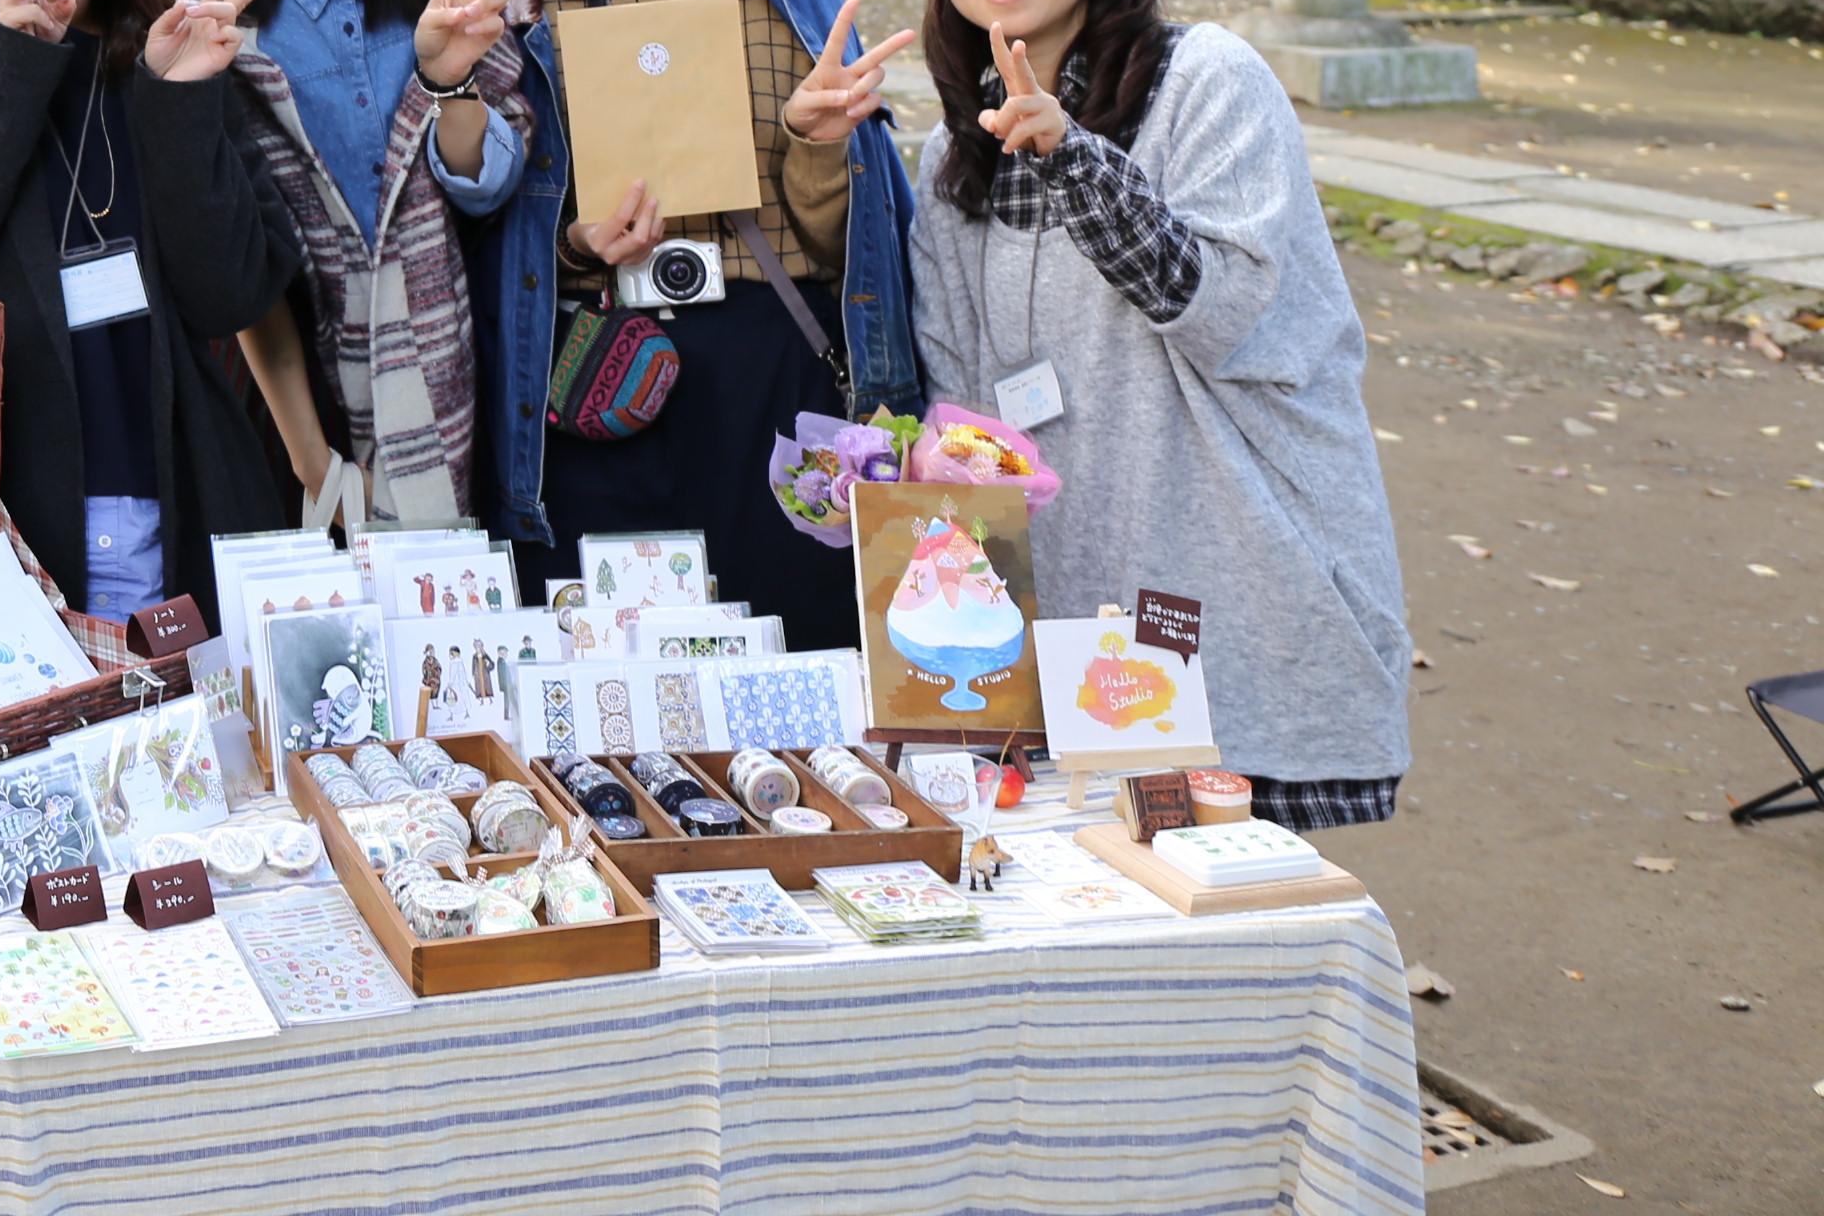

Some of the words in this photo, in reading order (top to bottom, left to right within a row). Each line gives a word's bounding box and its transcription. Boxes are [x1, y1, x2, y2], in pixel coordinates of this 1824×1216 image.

[917, 671, 947, 685] HELLO
[977, 670, 1011, 686] STUDIO
[1100, 672, 1138, 689] Hello
[1109, 687, 1153, 712] Studio
[46, 872, 90, 890] ポストカード
[152, 877, 182, 891] シール
